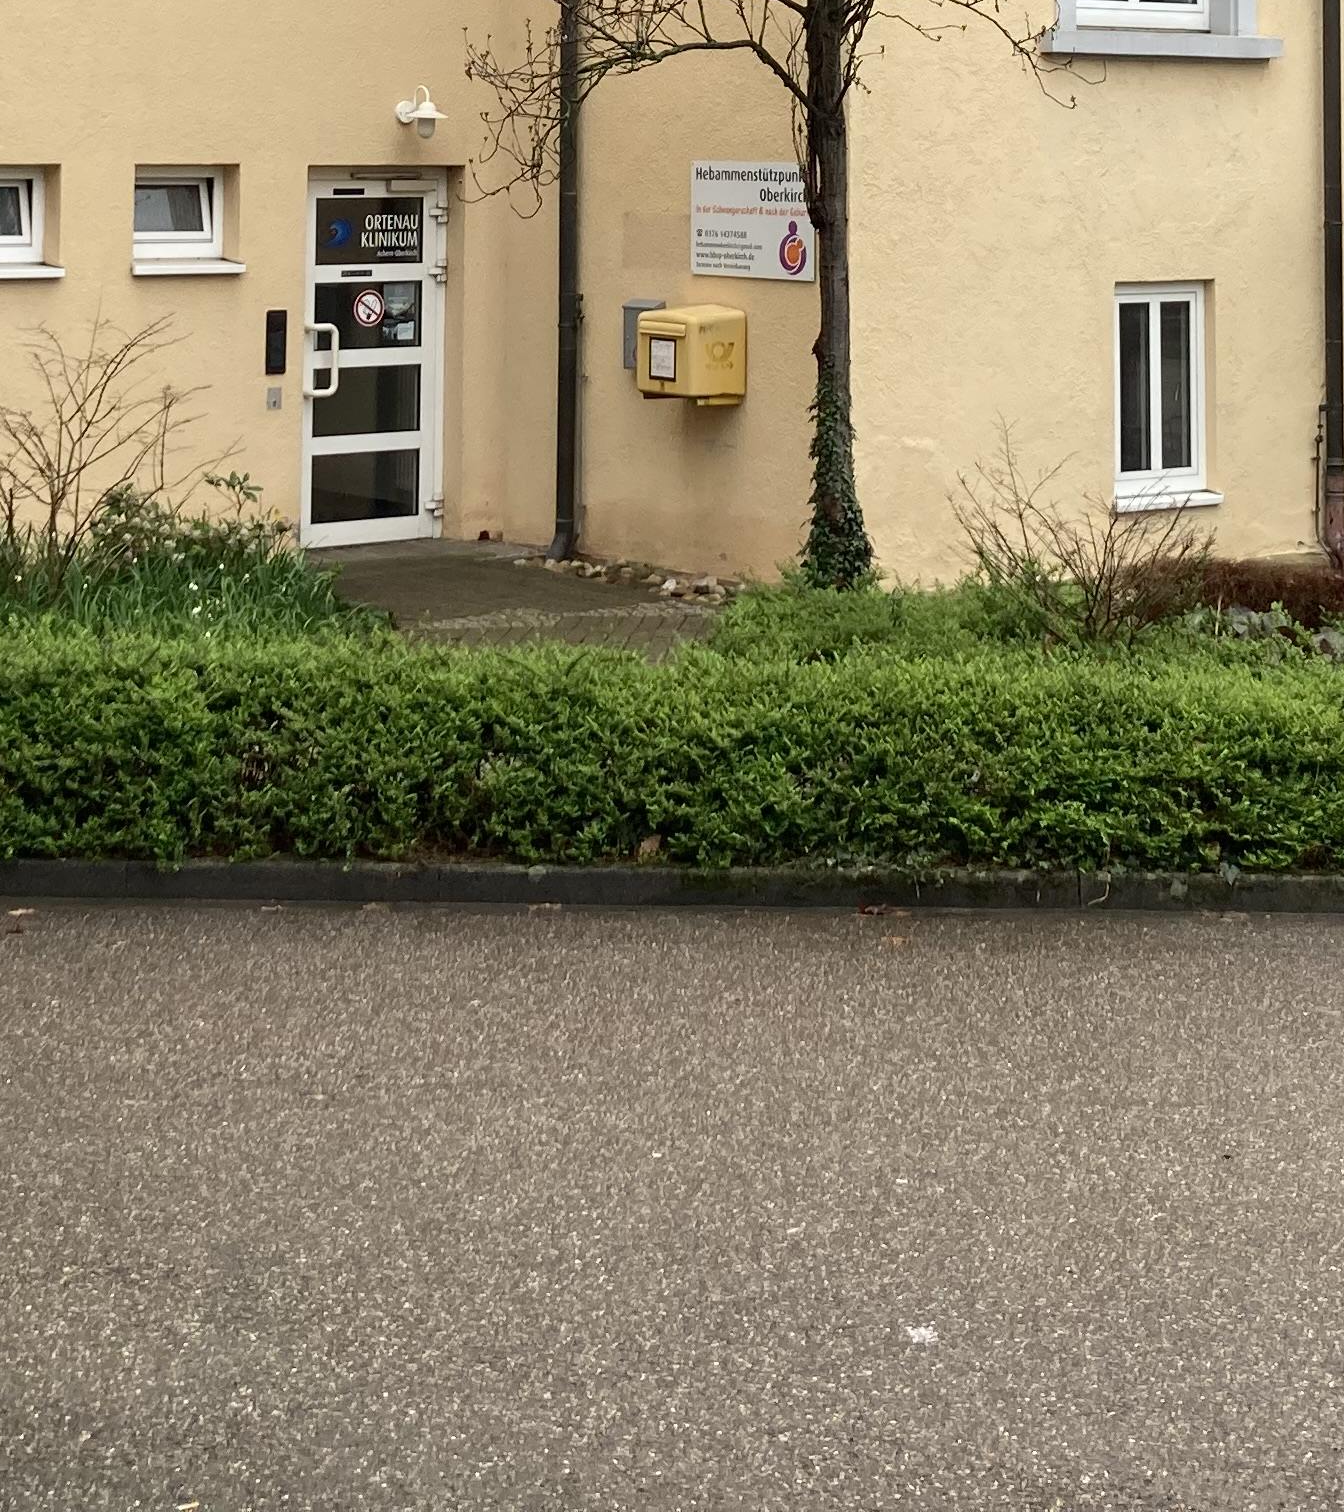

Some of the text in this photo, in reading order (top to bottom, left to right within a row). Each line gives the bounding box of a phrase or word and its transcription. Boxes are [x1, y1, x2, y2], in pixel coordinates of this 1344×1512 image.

[696, 166, 803, 185] Hebammenstützpun
[365, 214, 419, 230] ORTENAU
[361, 231, 418, 248] KLINIKUM
